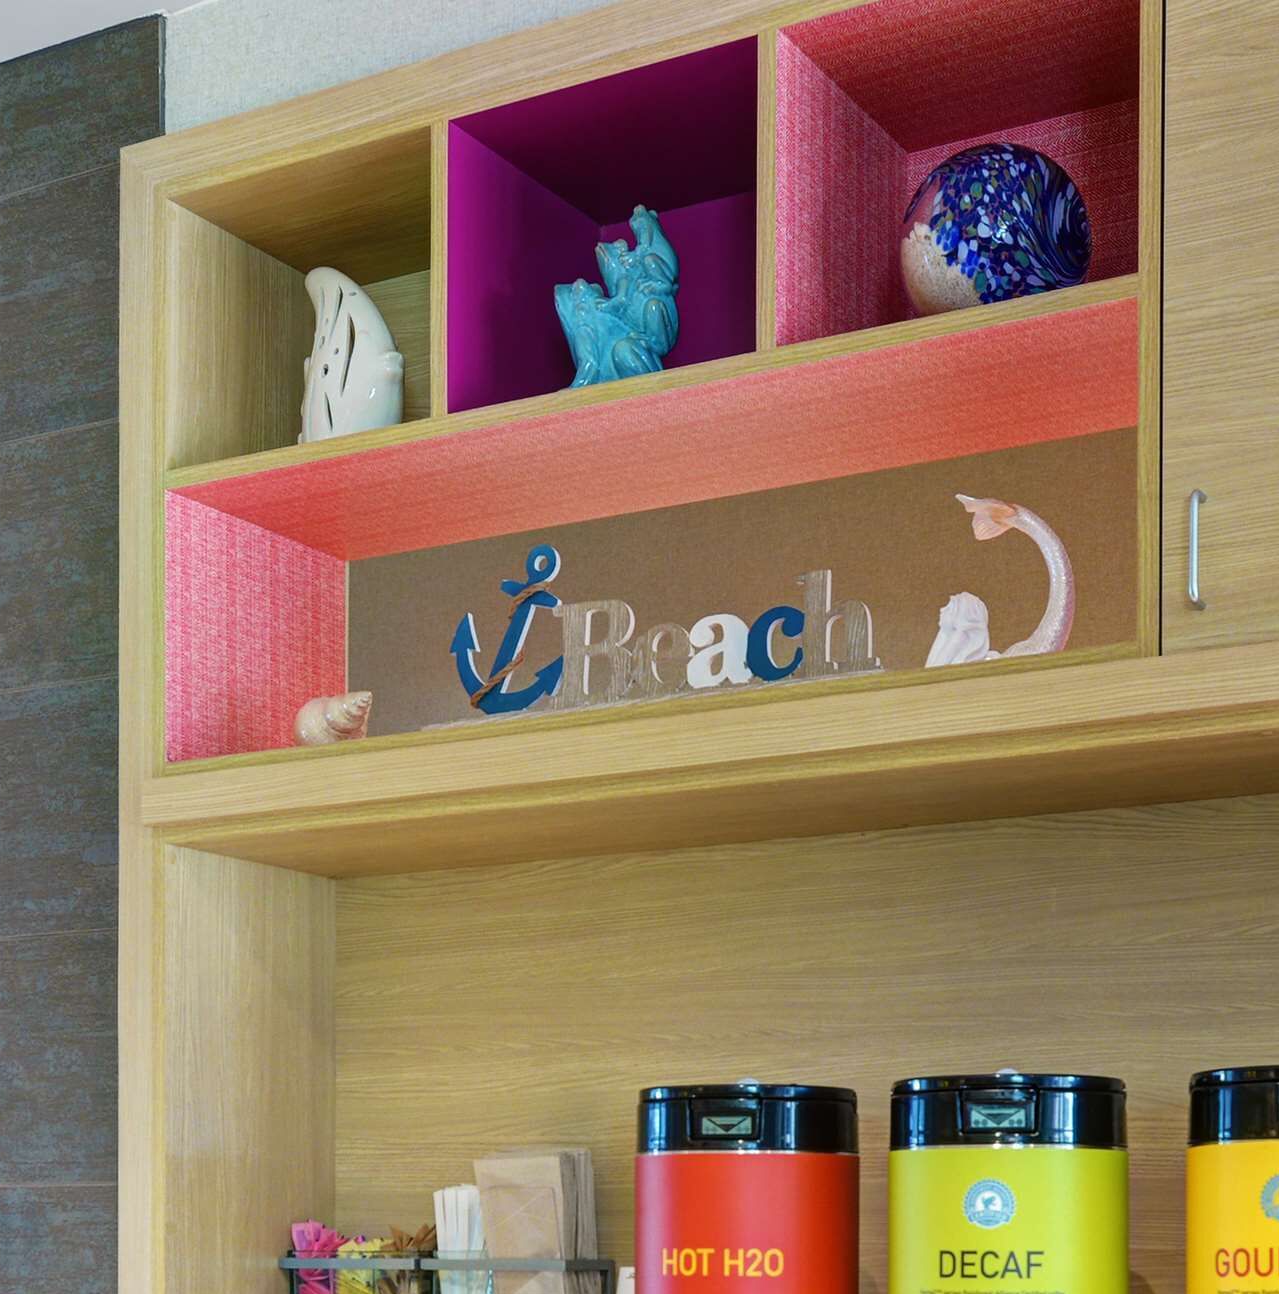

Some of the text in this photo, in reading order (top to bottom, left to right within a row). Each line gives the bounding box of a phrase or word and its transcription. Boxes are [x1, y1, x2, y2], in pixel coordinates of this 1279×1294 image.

[552, 568, 881, 703] Beach
[662, 1247, 715, 1277] HOT
[939, 1250, 1044, 1279] DECAF
